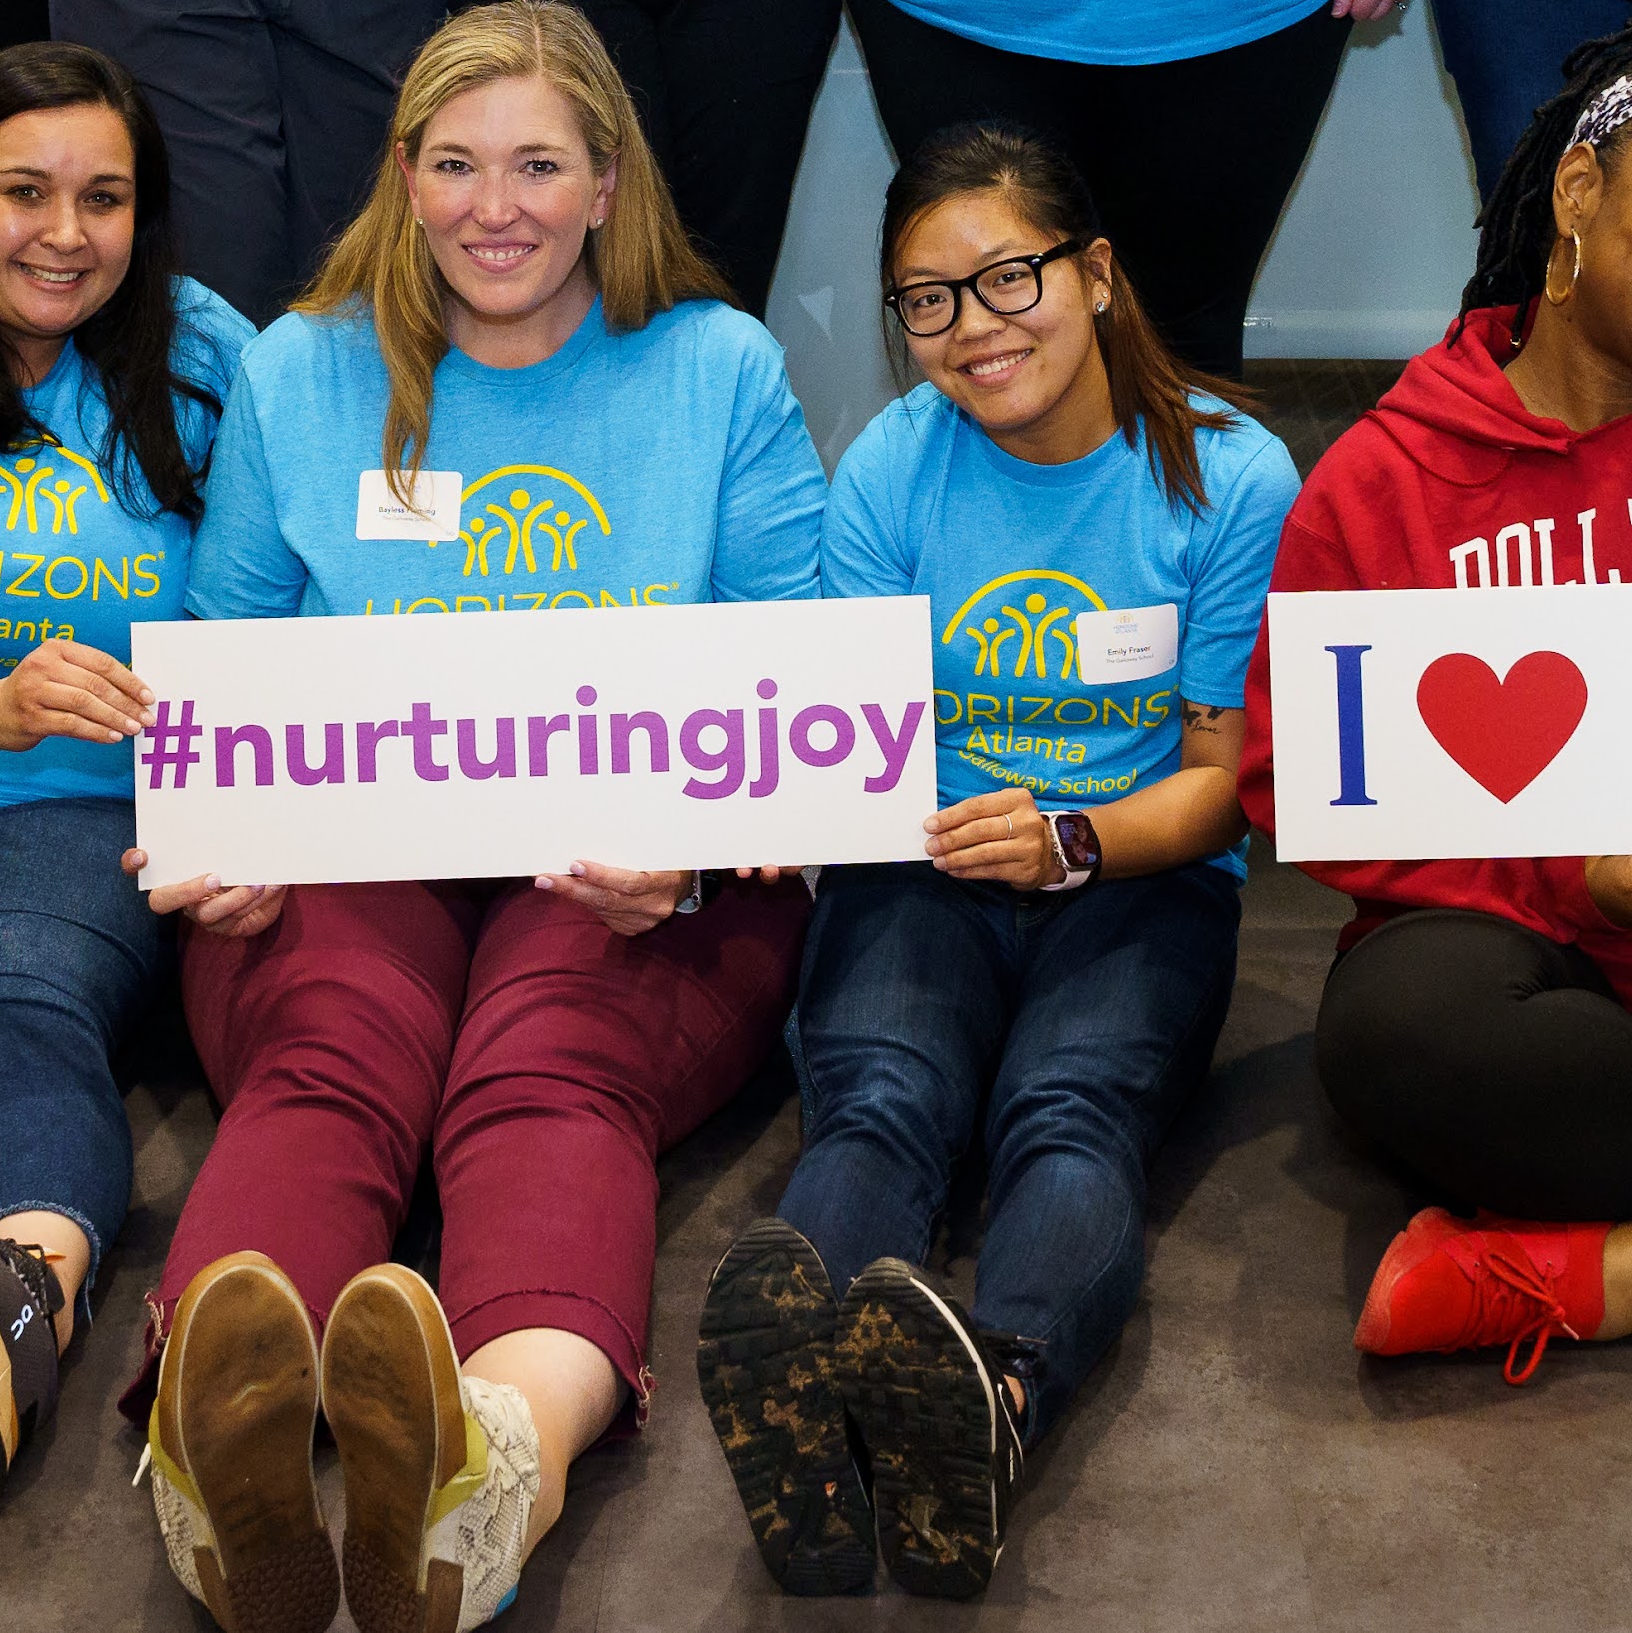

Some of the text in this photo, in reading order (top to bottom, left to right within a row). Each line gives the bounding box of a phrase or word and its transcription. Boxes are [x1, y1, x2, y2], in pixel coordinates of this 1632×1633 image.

[1107, 646, 1151, 656] Emily Fraser
[934, 689, 1171, 728] ORIZONS
[1324, 644, 1378, 806] I
[141, 678, 927, 800] #nurturingjoy
[966, 724, 1088, 764] Atlanta
[1058, 768, 1138, 795] School
